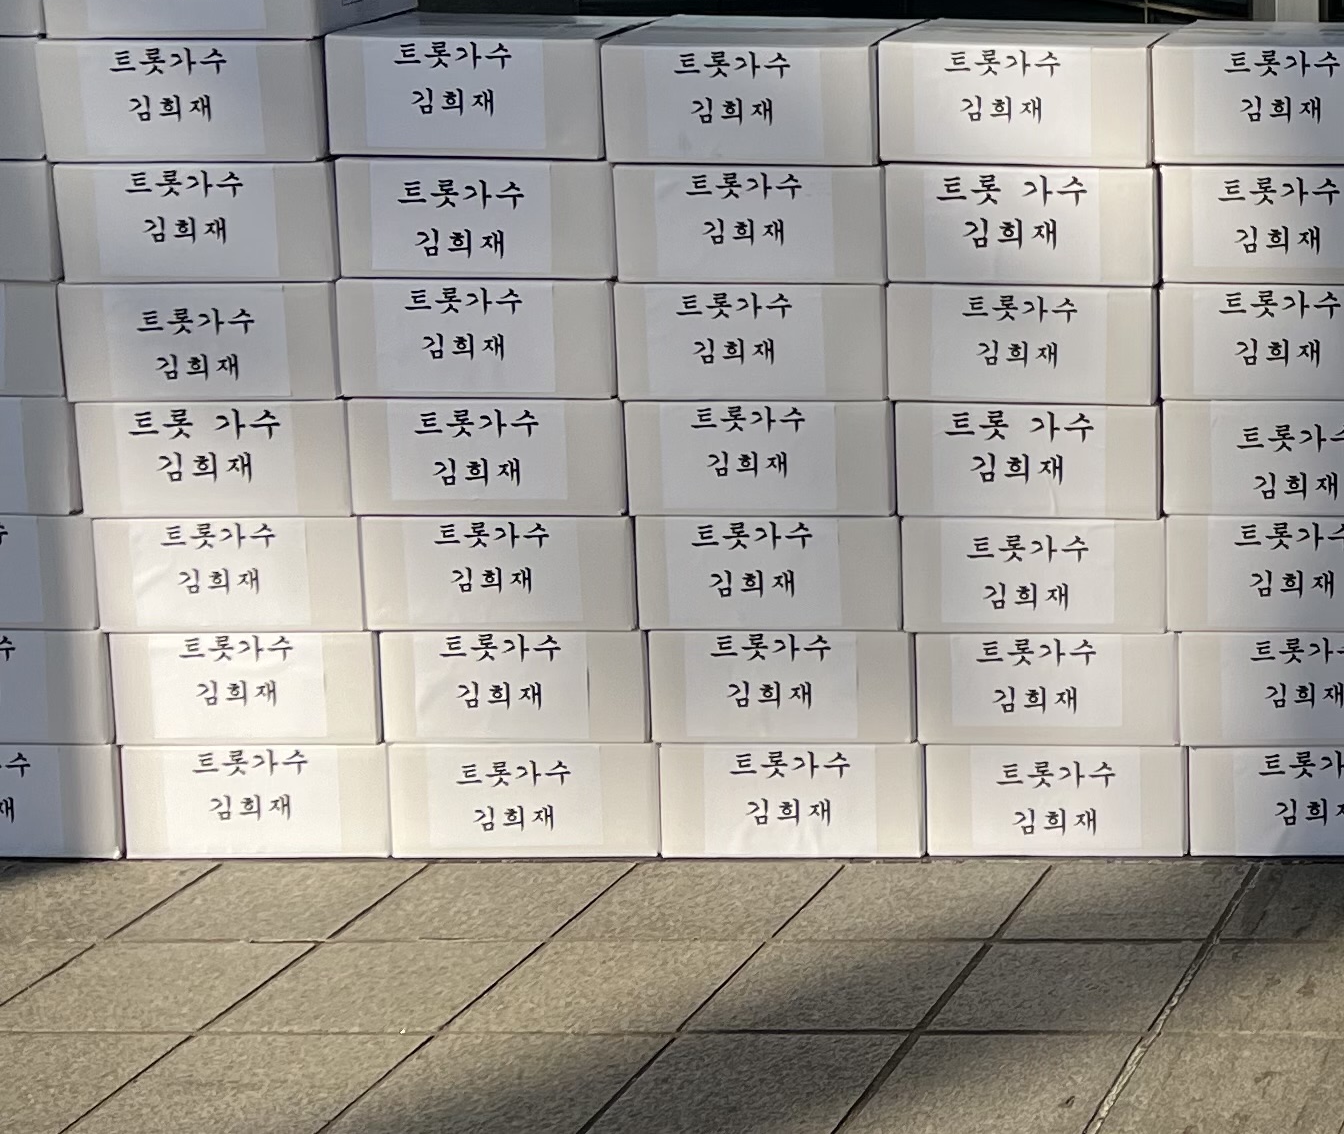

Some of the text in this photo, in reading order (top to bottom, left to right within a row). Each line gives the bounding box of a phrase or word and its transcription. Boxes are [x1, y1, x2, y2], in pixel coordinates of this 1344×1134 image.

[397, 178, 525, 210] 트롯가수
[1217, 176, 1341, 207] 트롯가수
[415, 227, 505, 260] 김희재
[1236, 225, 1321, 256] 김희재
[675, 291, 793, 320] 트롯가수
[693, 337, 775, 365] 김희재
[439, 633, 562, 663] 트롯가수
[458, 680, 542, 710] 김희재
[1265, 681, 1344, 709] 김희재
[193, 749, 308, 776] 트롯가수
[996, 760, 1116, 789] 트롯가수
[211, 793, 291, 821] 김희재
[1014, 807, 1097, 836] 김희재
